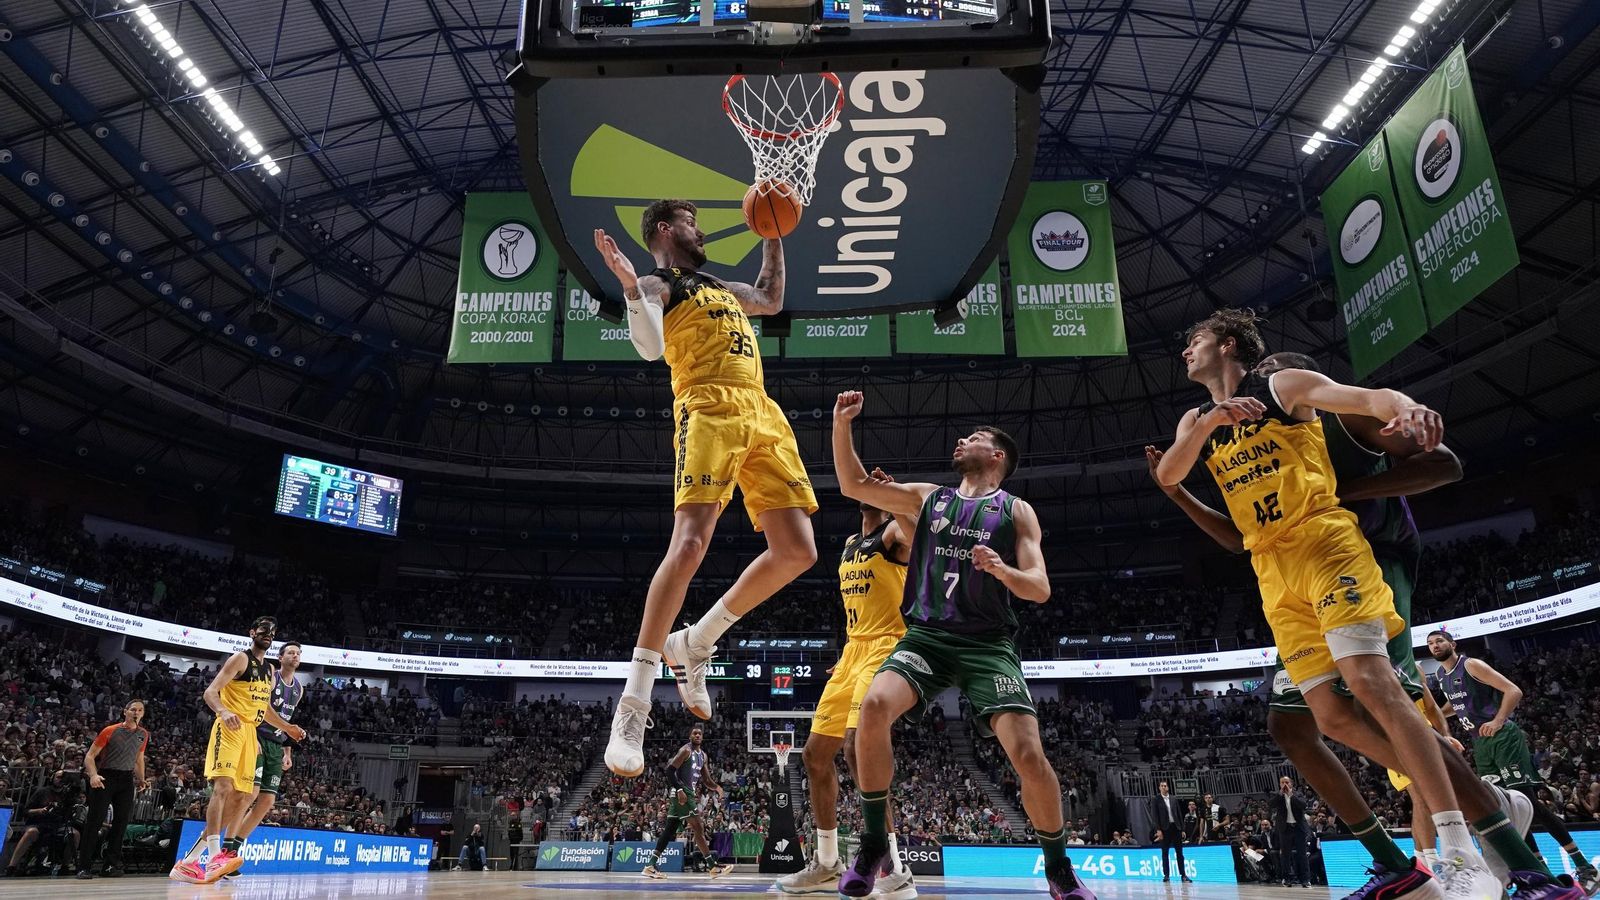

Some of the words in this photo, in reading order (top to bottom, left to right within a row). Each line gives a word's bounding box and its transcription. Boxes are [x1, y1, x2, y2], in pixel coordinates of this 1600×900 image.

[817, 70, 947, 295] Unicaja
[1414, 178, 1496, 264] CAMPEONES
[1421, 204, 1502, 279] SUPERCOPA
[1450, 250, 1480, 283] 2024
[1016, 282, 1116, 305] CAMPEONES
[1343, 254, 1408, 325] CAMPEONES
[457, 291, 553, 313] CAMPEONES
[972, 304, 999, 316] REY
[1055, 309, 1084, 321] BCL
[460, 313, 496, 324] COPA
[500, 312, 546, 324] KORAC
[470, 331, 534, 344] 2000/2001
[806, 325, 868, 337] 2016/2017
[1052, 324, 1087, 337] 2024
[1370, 317, 1394, 345] 2024
[729, 331, 754, 358] 35
[1221, 440, 1282, 471] LAGUNA
[324, 467, 336, 476] 39
[333, 491, 354, 502] 8:32
[1252, 491, 1283, 527] 42
[949, 525, 991, 541] Uncaja
[841, 569, 875, 582] LAGUNA
[943, 572, 960, 599] 7
[75, 614, 87, 623] Costa
[1479, 616, 1499, 625] Rincón
[1560, 598, 1572, 606] Vida
[132, 619, 143, 628] Vida
[746, 664, 761, 678] 39
[774, 676, 791, 688] 17
[255, 709, 265, 722] 15
[1459, 717, 1475, 731] 33
[238, 838, 277, 866] Hospital
[278, 839, 293, 860] HM
[294, 840, 304, 860] El
[304, 840, 323, 861] Pilar
[356, 844, 382, 866] Hospital
[382, 846, 393, 863] HM
[393, 846, 399, 862] El
[399, 846, 411, 862] Pilar
[561, 847, 605, 855] Fundación
[770, 854, 794, 862] Unicaja
[900, 848, 941, 862] desa
[560, 855, 592, 863] Unicaja
[1033, 855, 1116, 876] A-46
[1124, 855, 1152, 876] Las
